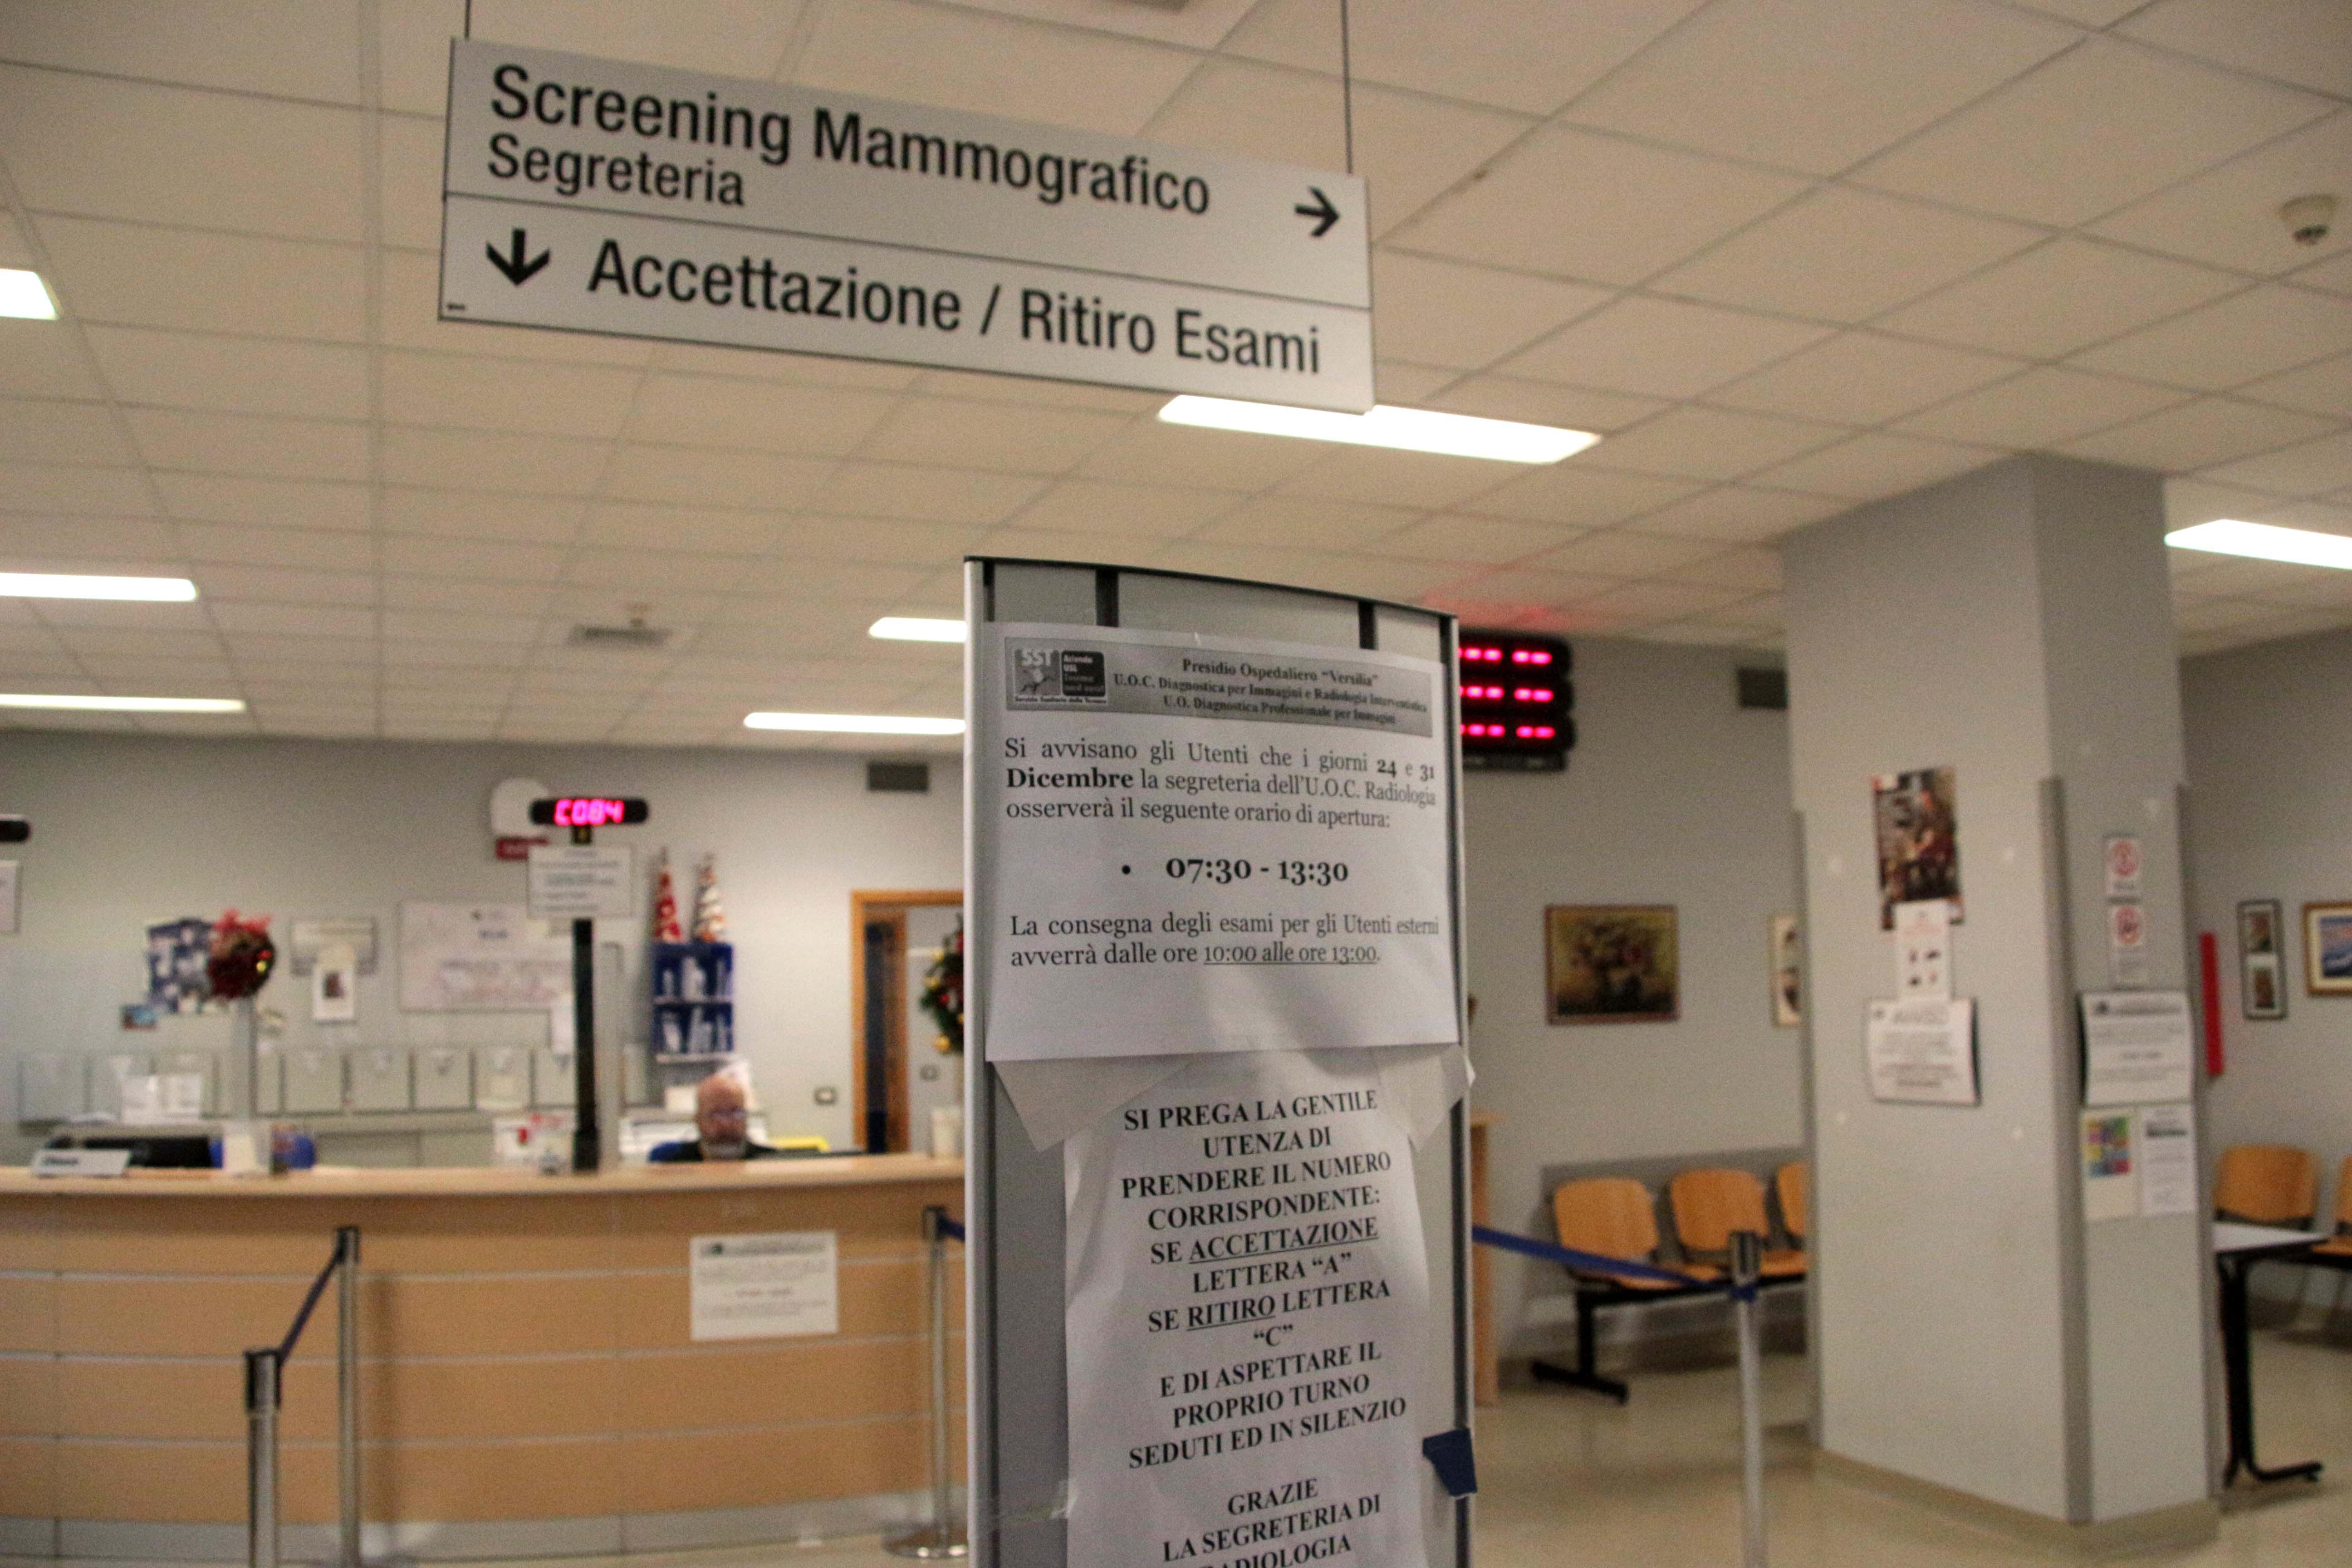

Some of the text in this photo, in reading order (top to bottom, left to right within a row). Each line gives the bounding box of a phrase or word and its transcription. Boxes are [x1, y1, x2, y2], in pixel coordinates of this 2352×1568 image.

[491, 64, 1210, 216] Screening Mammografico
[488, 132, 745, 207] Segreteria
[587, 239, 1319, 373] Accettazione / Ritiro Esami
[1113, 673, 1155, 688] U.O.C.
[1159, 677, 1225, 693] Diagnostica
[1227, 685, 1246, 696] per
[1249, 683, 1302, 699] Immagini
[1314, 688, 1367, 704] Radiologia
[1183, 658, 1236, 676] Presidio
[1240, 663, 1318, 681] Ospedaliero
[1163, 695, 1190, 708] U.O.
[1193, 697, 1259, 713] Diagnostica
[1004, 736, 1435, 781] Si avvisano gli Utenti che i giorni 24 e 31
[1006, 767, 1133, 788] Dicembre
[1142, 768, 1159, 789] la
[1165, 773, 1261, 796] segreteria
[1365, 781, 1436, 809] Radiologia
[1006, 797, 1390, 829] osserverà il seguente orario di apertura:
[1166, 858, 1252, 884] 07:30
[1278, 860, 1349, 887] 13:30
[1010, 911, 1440, 939] La consegna degli esami per gli Utenti esterni
[1011, 941, 1381, 966] avverrà dalle ore 10:00 alle ore 13:00.
[1124, 1089, 1377, 1131] SI PREGA LA GENTILE
[1203, 1126, 1331, 1158] UTENZA DI
[1121, 1151, 1392, 1199] PRENDERE IL NUMERO
[1147, 1185, 1381, 1231] CORRISPONDENTE:
[1150, 1216, 1379, 1264] SE ACCETTAZIONE
[1192, 1260, 1306, 1293] LETTERA
[1147, 1279, 1391, 1333] SE RITIRO LETTERA
[1160, 1341, 1382, 1398] E DI ASPETTARE IL
[1173, 1373, 1370, 1429] PROPRIO TURNO
[1128, 1397, 1406, 1469] SEDUTI ED IN SILENZIO
[1227, 1477, 1318, 1516] GRAZIE
[1162, 1493, 1382, 1563] LA SEGRETERIA DI
[1200, 1534, 1352, 1568] DIOLOGIA
